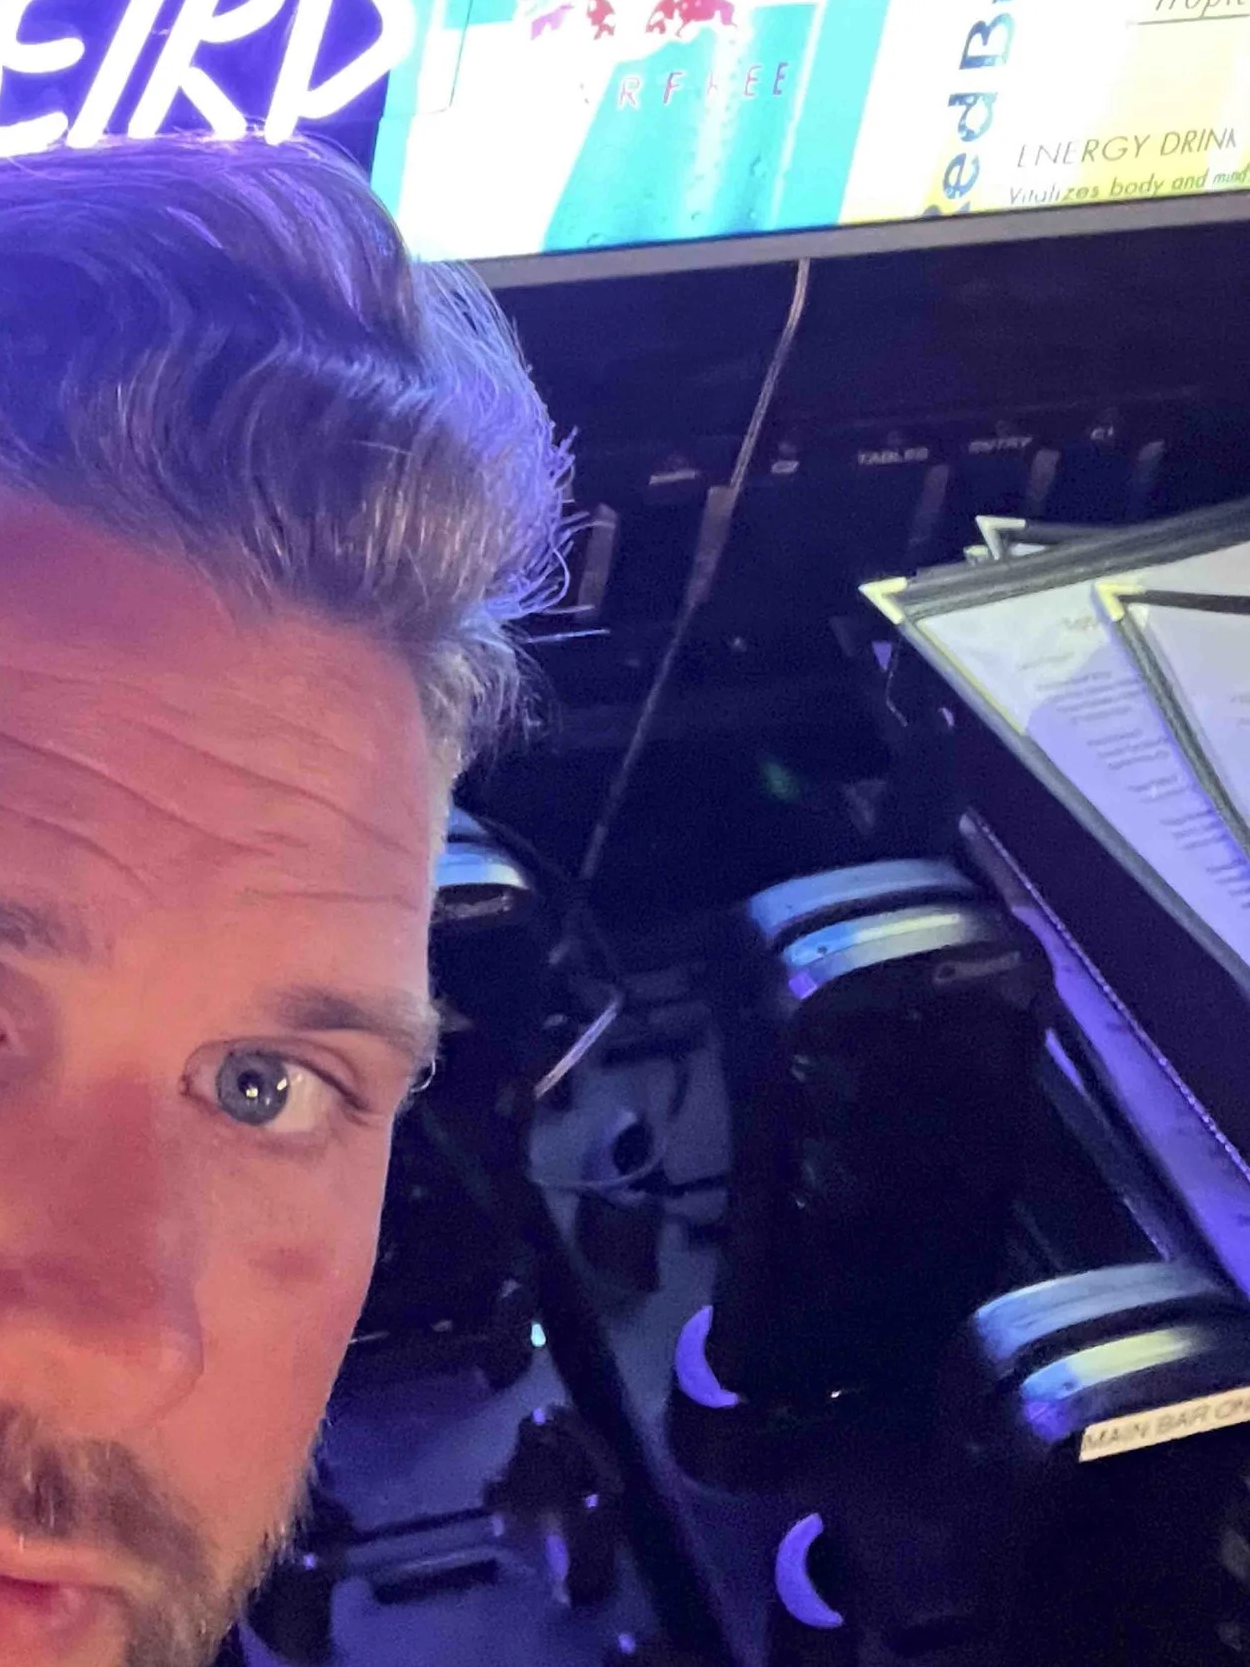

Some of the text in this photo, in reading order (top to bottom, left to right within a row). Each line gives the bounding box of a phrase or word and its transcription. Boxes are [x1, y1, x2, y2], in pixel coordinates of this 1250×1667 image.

[1016, 133, 1151, 169] ENERGY
[1110, 172, 1165, 197] body
[1171, 167, 1210, 191] and
